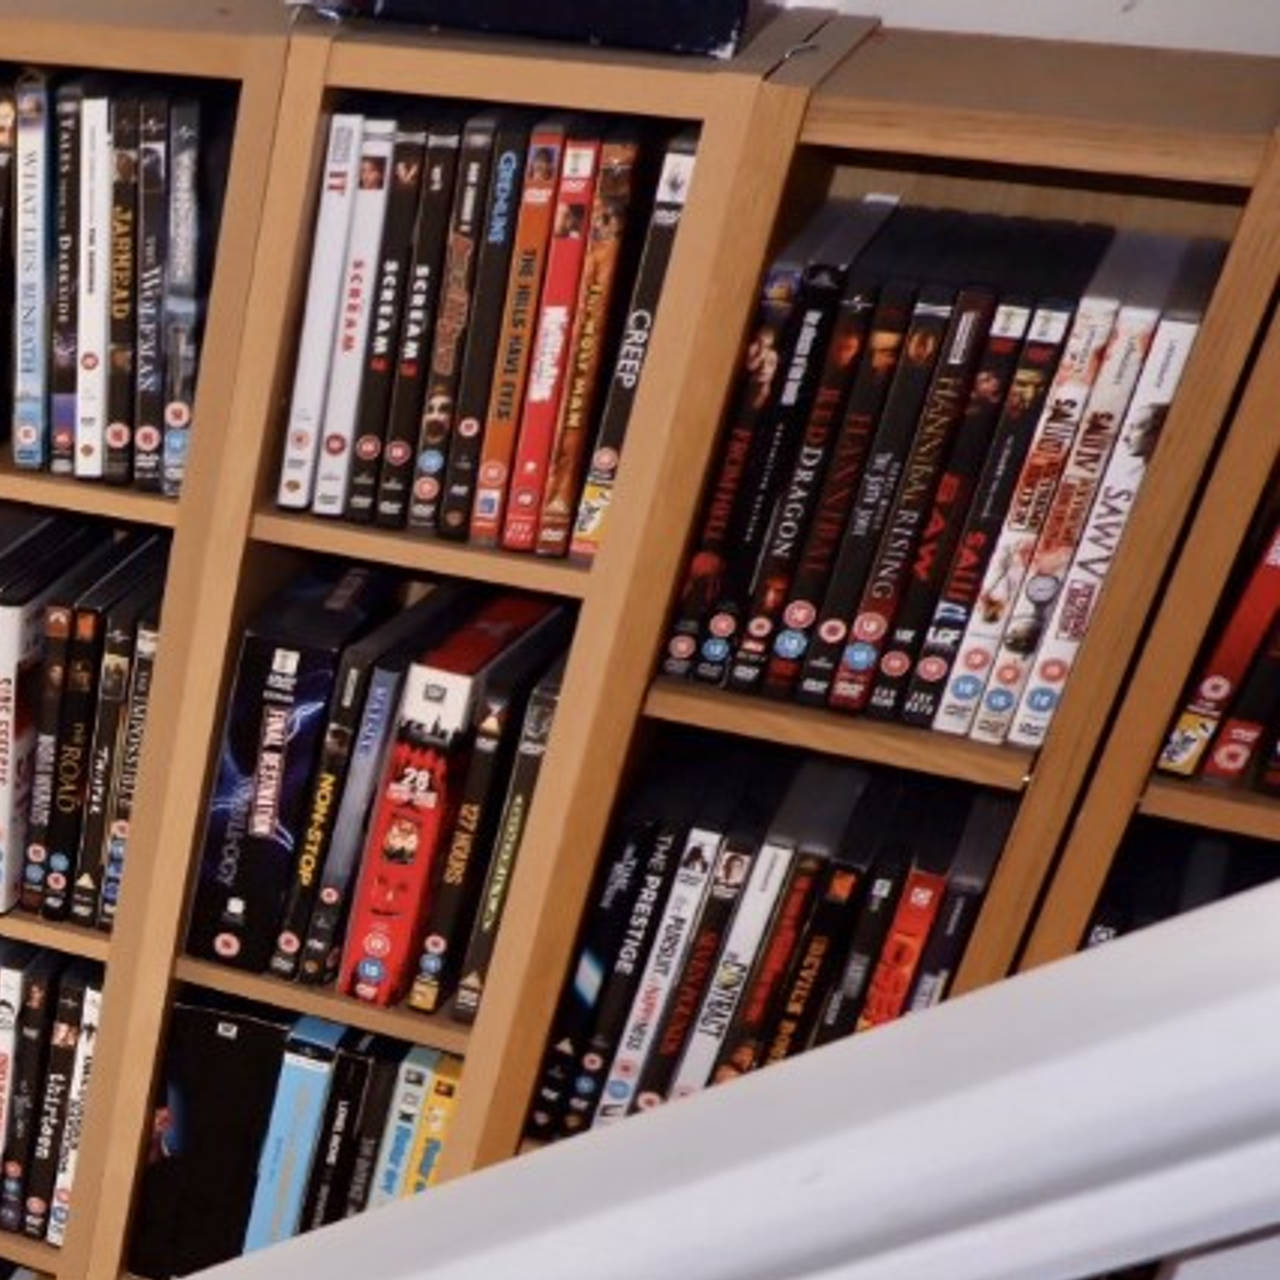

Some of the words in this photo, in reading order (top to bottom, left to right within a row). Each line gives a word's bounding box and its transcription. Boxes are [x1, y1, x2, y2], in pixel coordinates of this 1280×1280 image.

[60, 117, 74, 172] TALES
[22, 151, 37, 214] WHAT
[326, 169, 348, 196] IT
[22, 227, 36, 272] LIES
[56, 234, 72, 322] DARKSIDE
[110, 205, 133, 319] JARHEAD
[517, 247, 537, 279] THE
[20, 283, 37, 373] BENEATH
[137, 264, 161, 391] WOLFMAN
[340, 259, 365, 352] SCREAM
[371, 259, 399, 355] SCREAM
[402, 263, 429, 360] SCREAM
[509, 282, 533, 330] HILLS
[502, 334, 523, 376] HAVE
[613, 306, 651, 389] CREEP
[494, 380, 516, 422] EYES
[565, 377, 586, 429] MAN
[804, 385, 840, 446] RED
[718, 427, 750, 489] FROM
[898, 373, 961, 509] HANNIBAL
[705, 489, 733, 542] HELL
[770, 444, 823, 560] DRAGON
[801, 407, 871, 578] HANNIBAL
[907, 470, 963, 582] SAW
[1084, 482, 1130, 554] SAW
[869, 504, 920, 603] RISING
[1075, 546, 1108, 578] V
[116, 694, 148, 810] IMPOSSIBLE
[259, 707, 290, 750] FINAL
[54, 744, 83, 814] ROAD
[401, 768, 431, 791] 28
[294, 771, 337, 888] NON-STOP
[455, 800, 479, 831] 127
[442, 830, 473, 887] HOURS
[645, 830, 674, 873] THE
[612, 871, 661, 977] PRESTIGE
[649, 913, 689, 979] PURSUIT
[623, 982, 664, 1055] HAPPYNESS
[697, 957, 748, 1042] CONTRACT
[35, 1071, 66, 1160] thirteen
